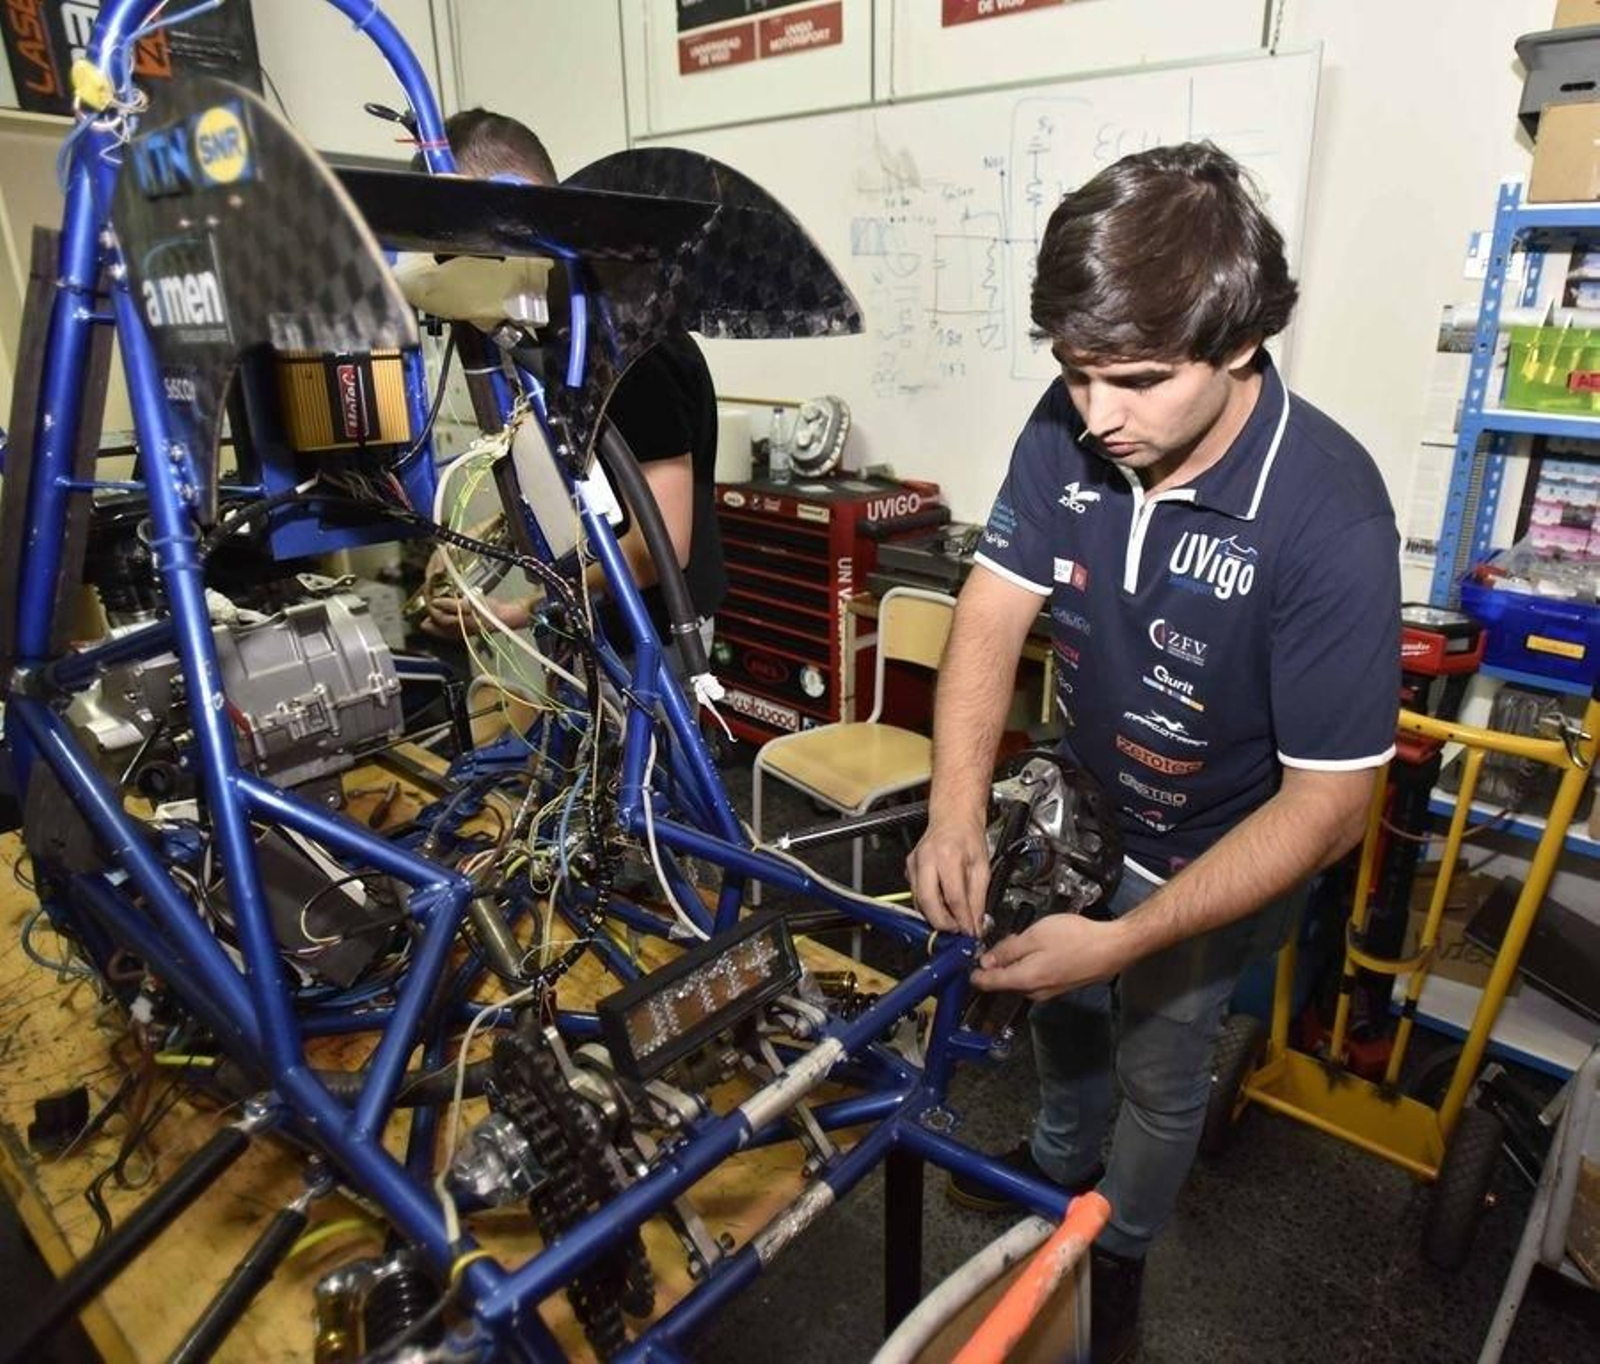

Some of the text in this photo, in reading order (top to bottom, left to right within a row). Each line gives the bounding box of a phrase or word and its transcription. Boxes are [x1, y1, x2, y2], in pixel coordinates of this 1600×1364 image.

[199, 127, 238, 164] SNR
[867, 493, 921, 521] UVIGO
[1169, 531, 1255, 600] UVigo
[1153, 665, 1194, 696] Gurit
